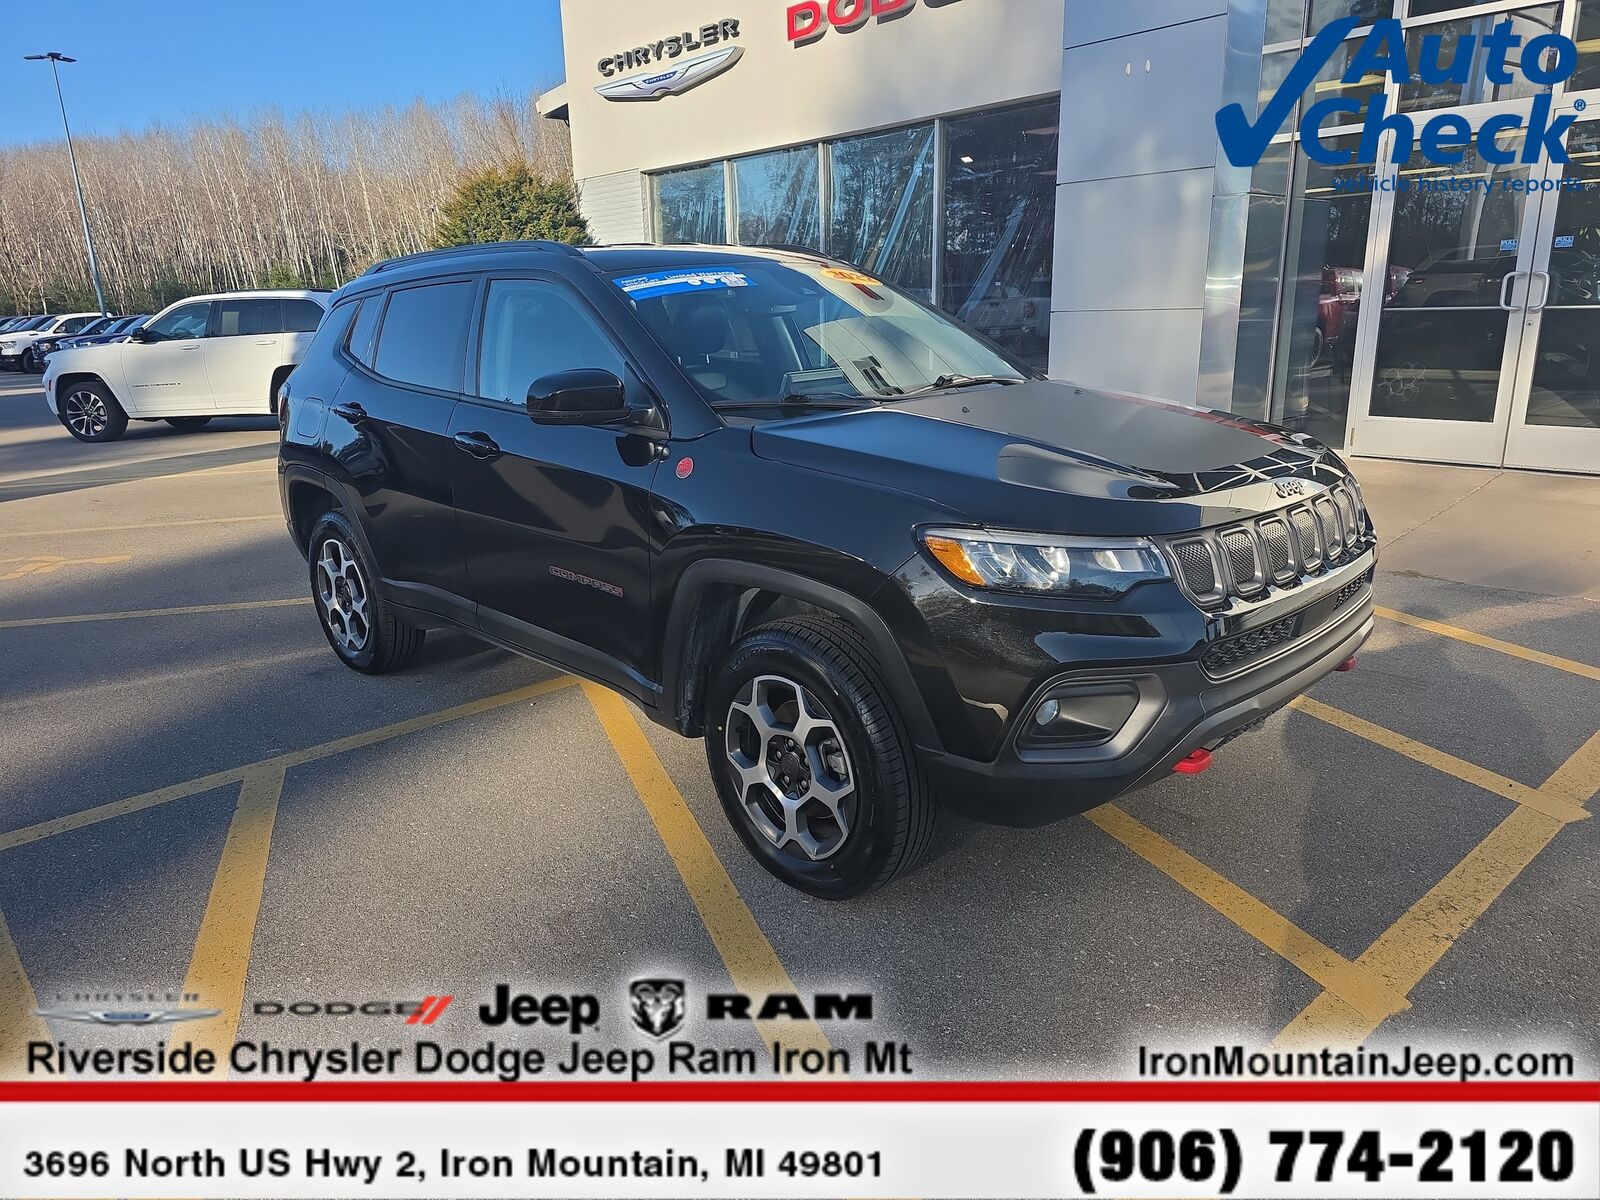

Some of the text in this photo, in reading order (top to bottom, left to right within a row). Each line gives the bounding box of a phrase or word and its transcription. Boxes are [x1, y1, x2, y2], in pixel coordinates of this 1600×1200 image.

[597, 18, 742, 77] CHRYSLER
[1274, 479, 1305, 499] Jeep
[548, 565, 624, 598] COMPASS
